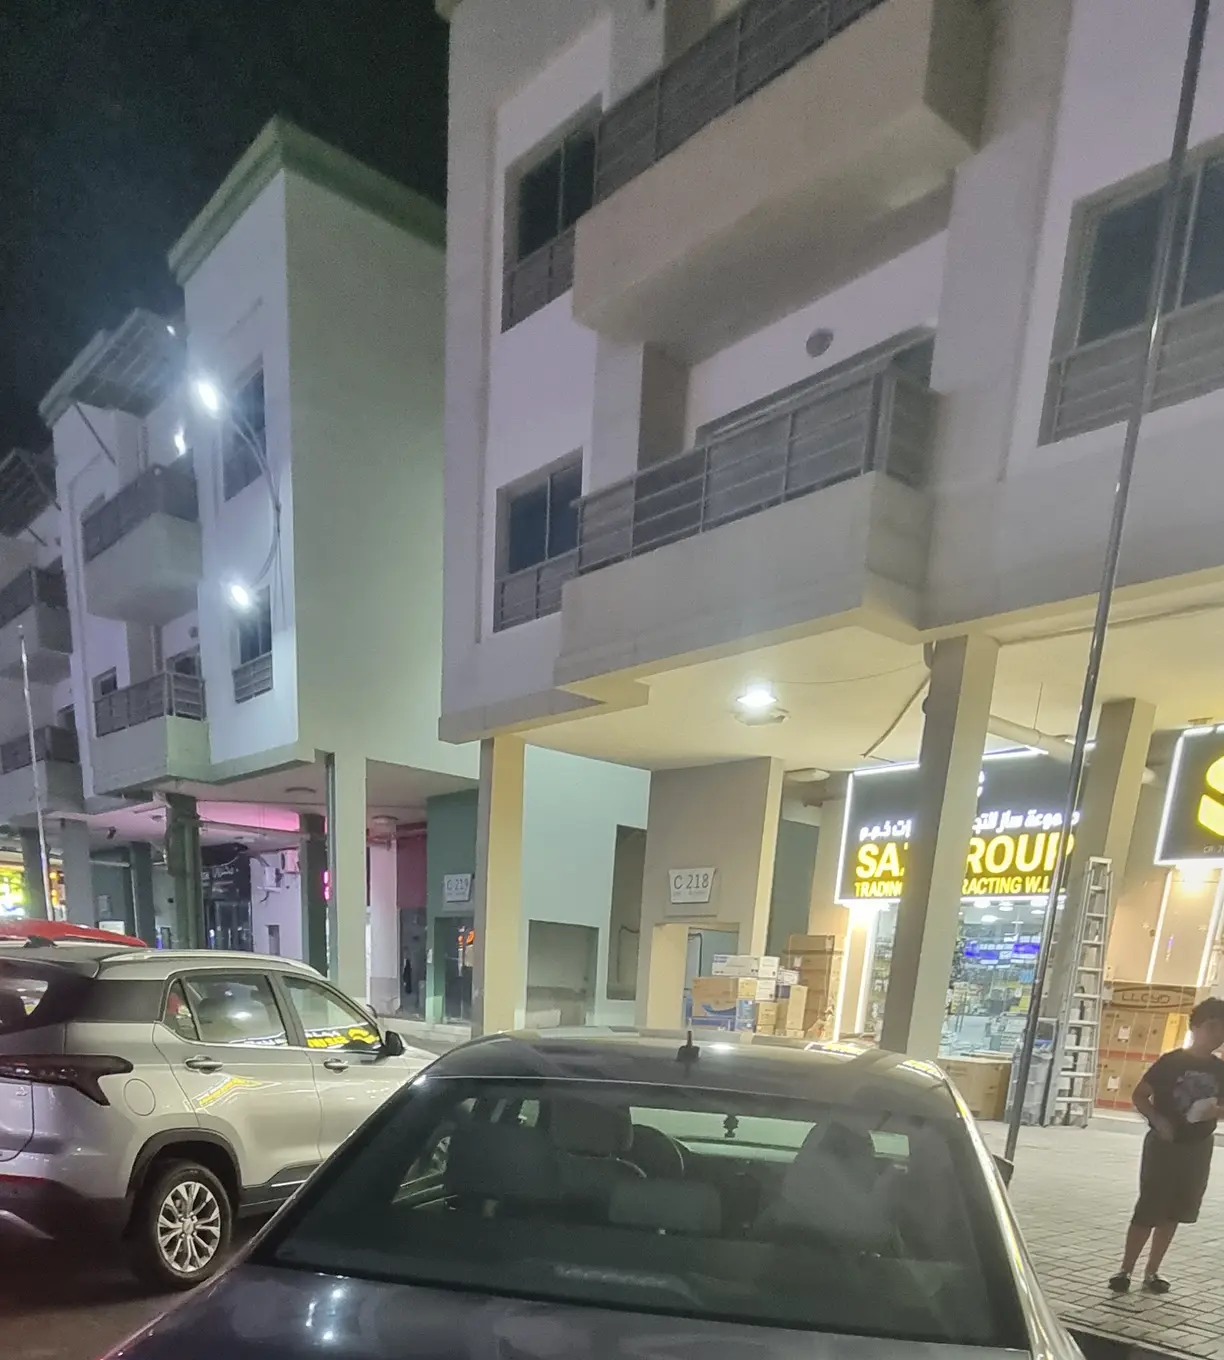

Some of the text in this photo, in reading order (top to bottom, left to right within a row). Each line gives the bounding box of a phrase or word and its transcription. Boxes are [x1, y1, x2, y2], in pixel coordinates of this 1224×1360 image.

[855, 831, 1075, 879] SA ROUP
[673, 873, 709, 890] C 218
[854, 880, 903, 898] TRADIN
[961, 876, 1023, 895] RACTING
